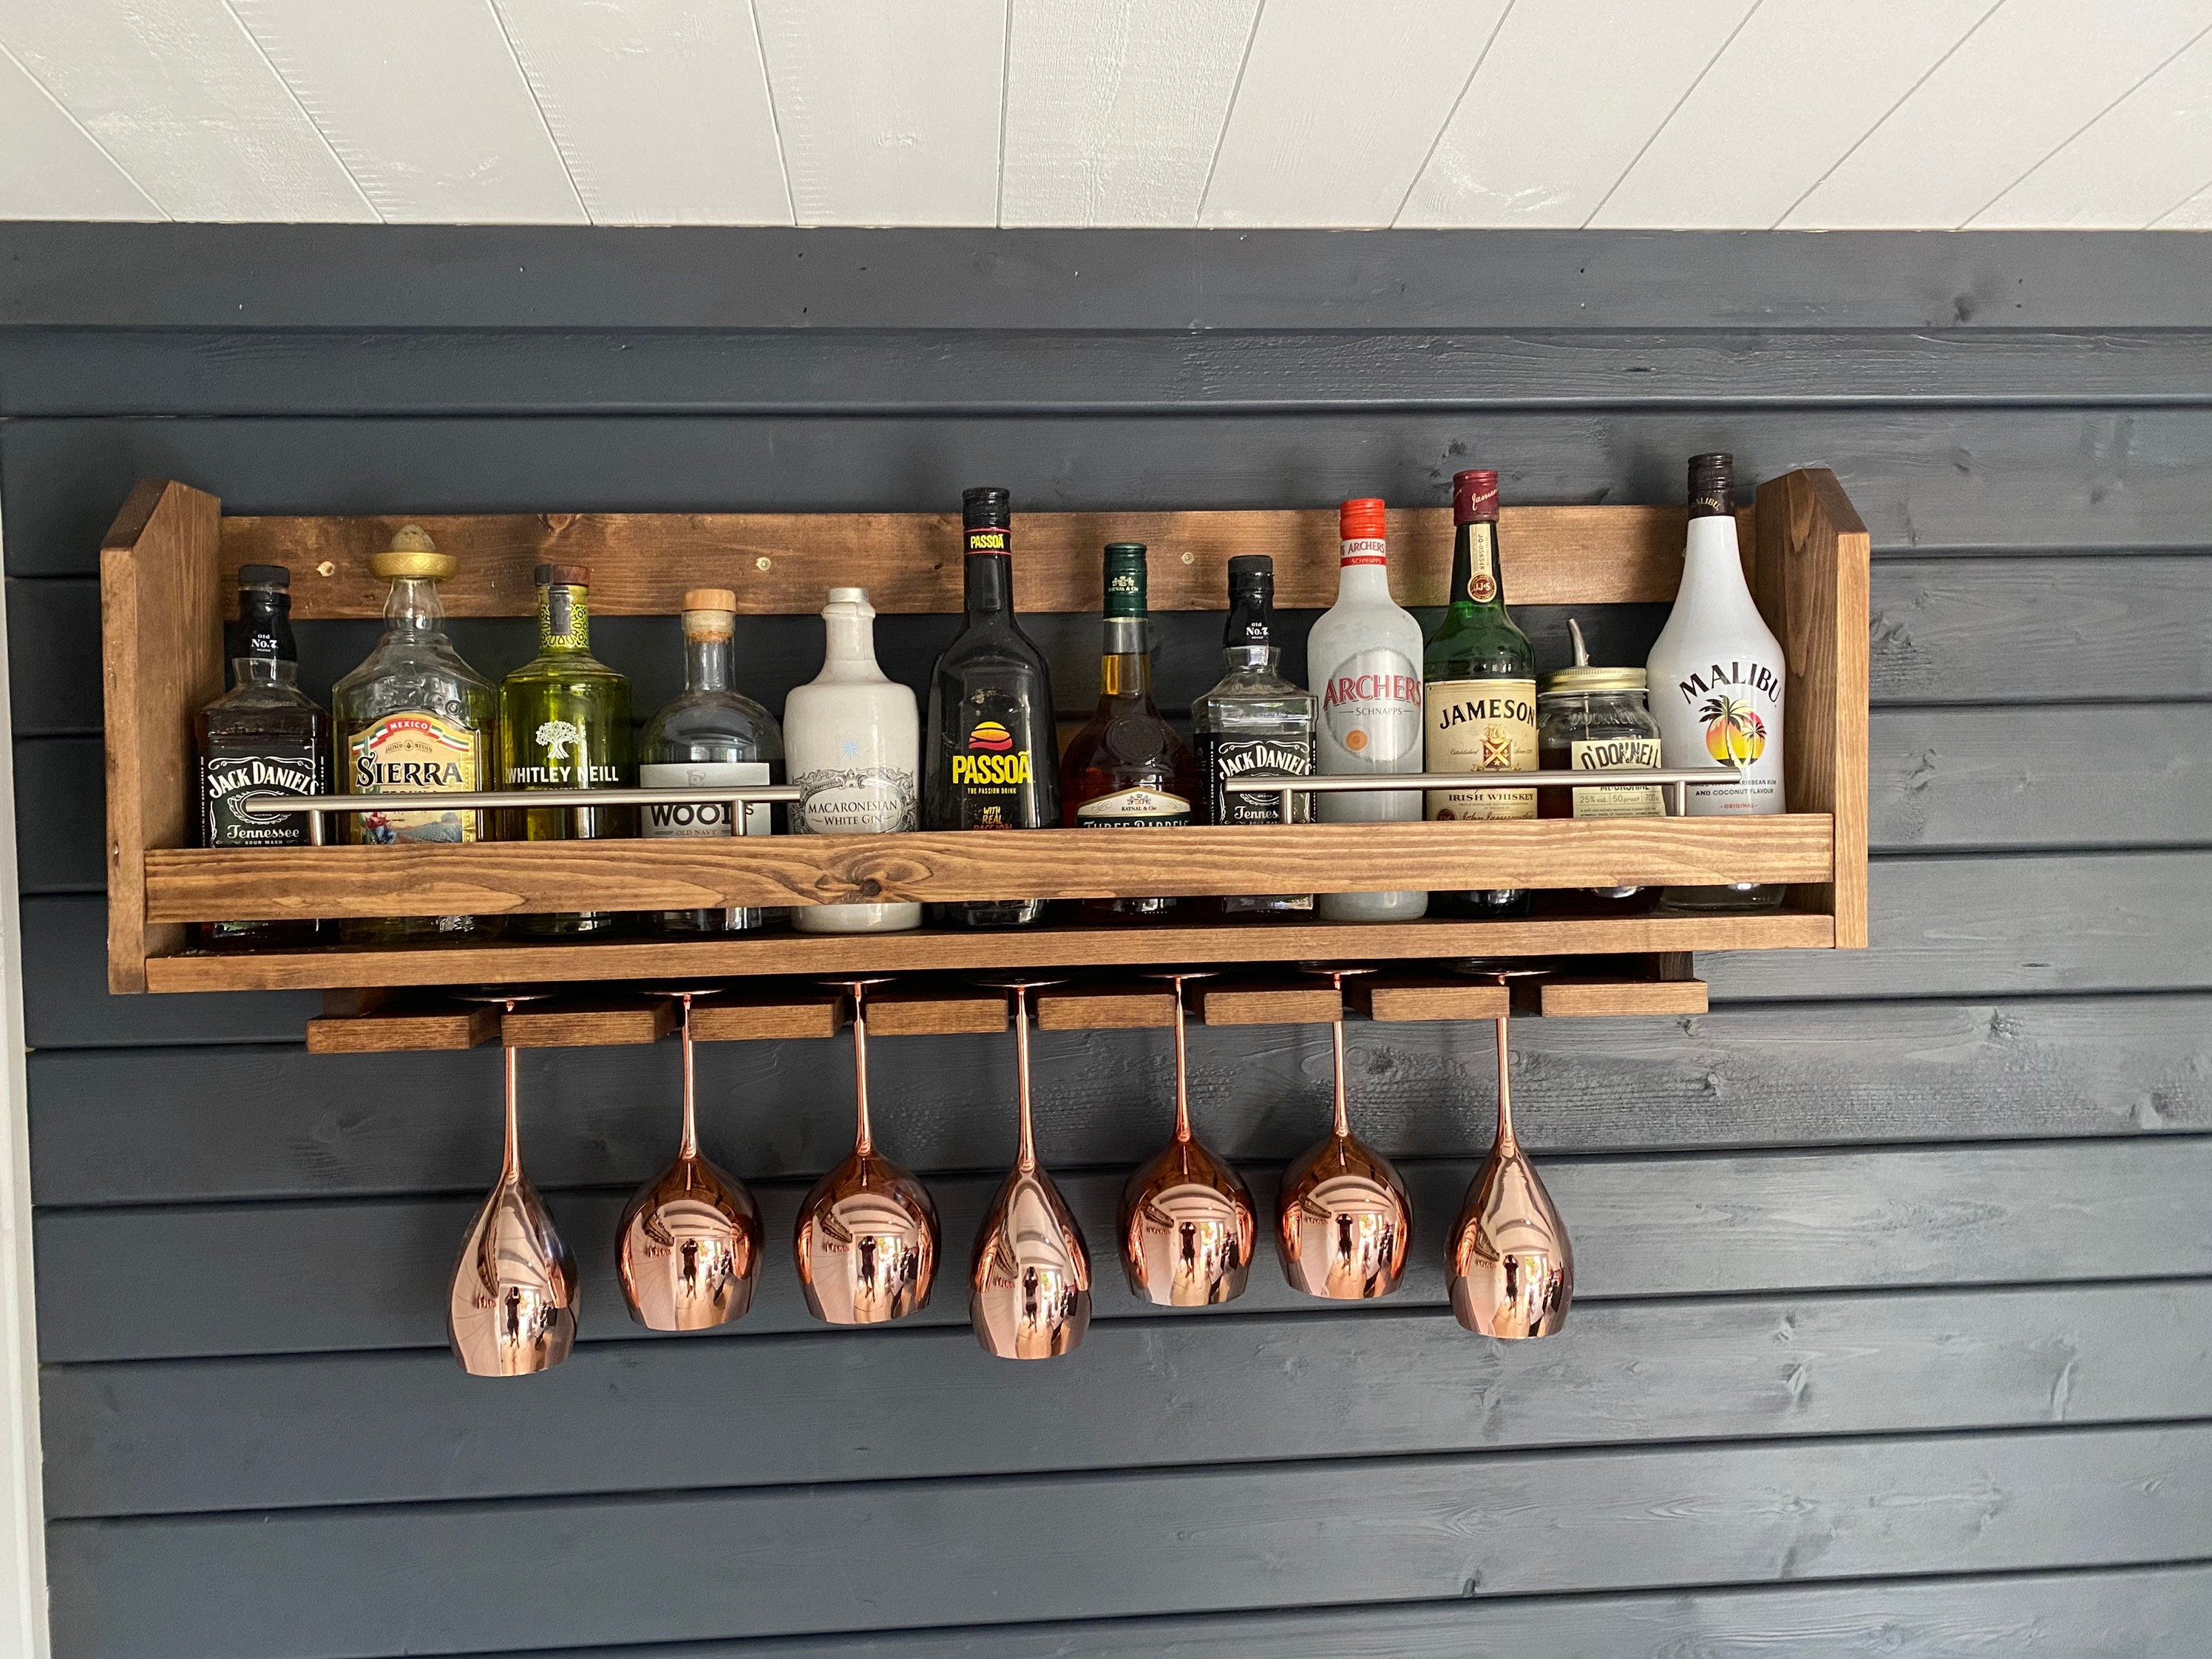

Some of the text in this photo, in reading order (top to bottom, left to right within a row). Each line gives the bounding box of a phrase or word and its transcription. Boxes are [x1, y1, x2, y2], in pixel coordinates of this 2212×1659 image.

[1348, 541, 1385, 554] ARCHERS
[1246, 627, 1269, 636] No.7
[251, 639, 278, 648] No.7
[1679, 662, 1781, 705] MALIBU
[1323, 674, 1422, 711] ARCHERS
[1356, 707, 1402, 716] SCHNAPPS
[1439, 699, 1535, 730] JAMESON
[390, 721, 428, 730] MEXICO
[356, 752, 463, 787] SIERRA
[952, 750, 1034, 784] PASSOÃ
[1218, 751, 1256, 780] JACK
[507, 766, 620, 784] WHITLEY NEILL
[208, 767, 252, 798] JACK
[1448, 793, 1483, 801] IRISH
[1579, 795, 1595, 804] 25%
[808, 800, 898, 814] MACARONESIAN
[983, 806, 1001, 815] WITH
[824, 815, 882, 825] WHITE GIN
[982, 814, 1002, 824] REAL
[226, 824, 299, 839] Tennessee
